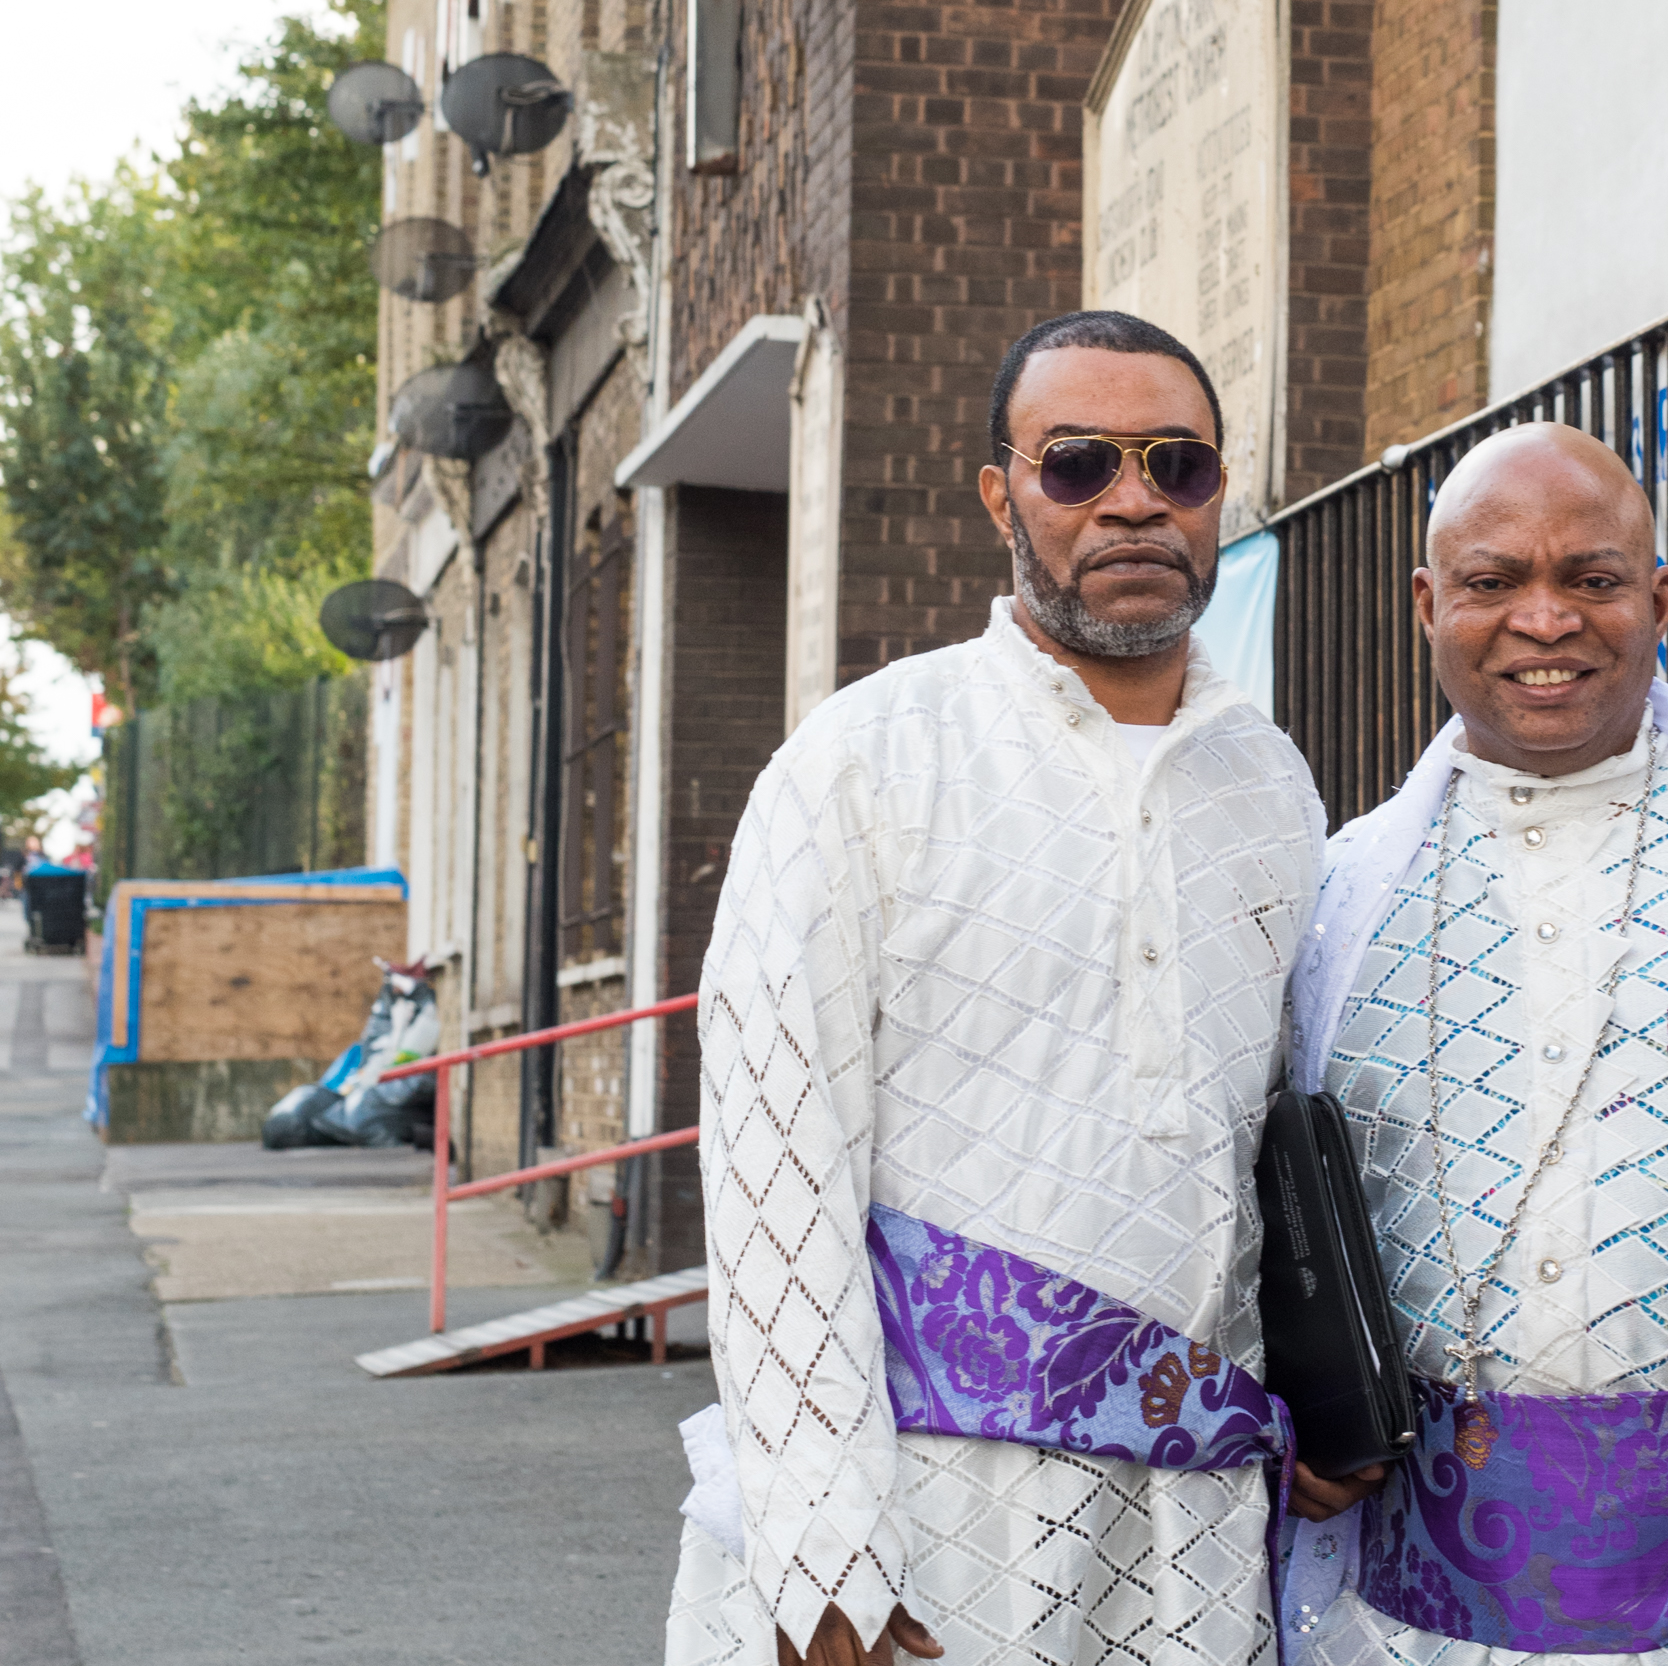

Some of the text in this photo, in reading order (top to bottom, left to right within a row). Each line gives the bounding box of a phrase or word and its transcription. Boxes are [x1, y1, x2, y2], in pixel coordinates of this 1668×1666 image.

[1284, 1151, 1296, 1190] London
[1292, 1192, 1299, 1203] of
[1284, 1213, 1292, 1225] of
[1284, 1180, 1306, 1258] Royal Holloway
[1296, 1205, 1311, 1256] University
